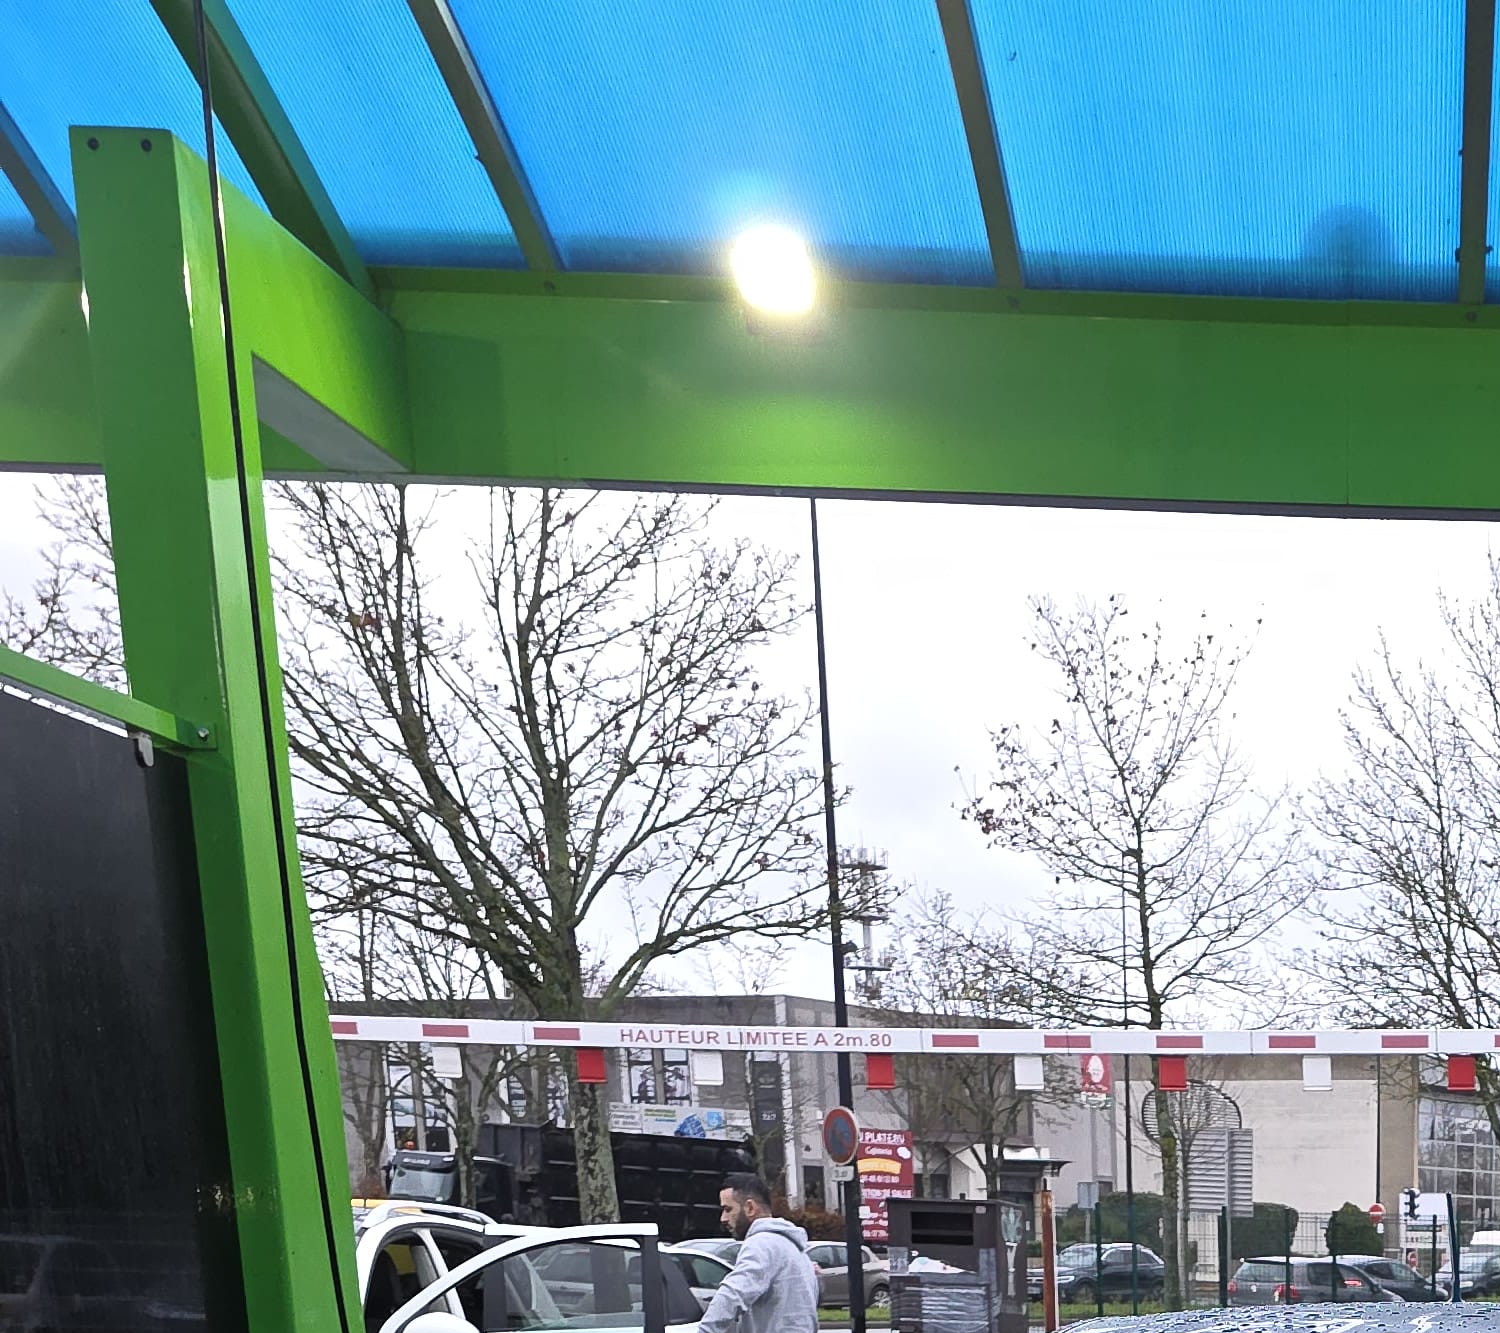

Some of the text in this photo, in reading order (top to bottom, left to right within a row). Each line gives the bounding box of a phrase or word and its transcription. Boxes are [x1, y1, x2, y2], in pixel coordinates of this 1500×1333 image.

[620, 1028, 892, 1048] HAUTEUR LIMITEE A 2m.80
